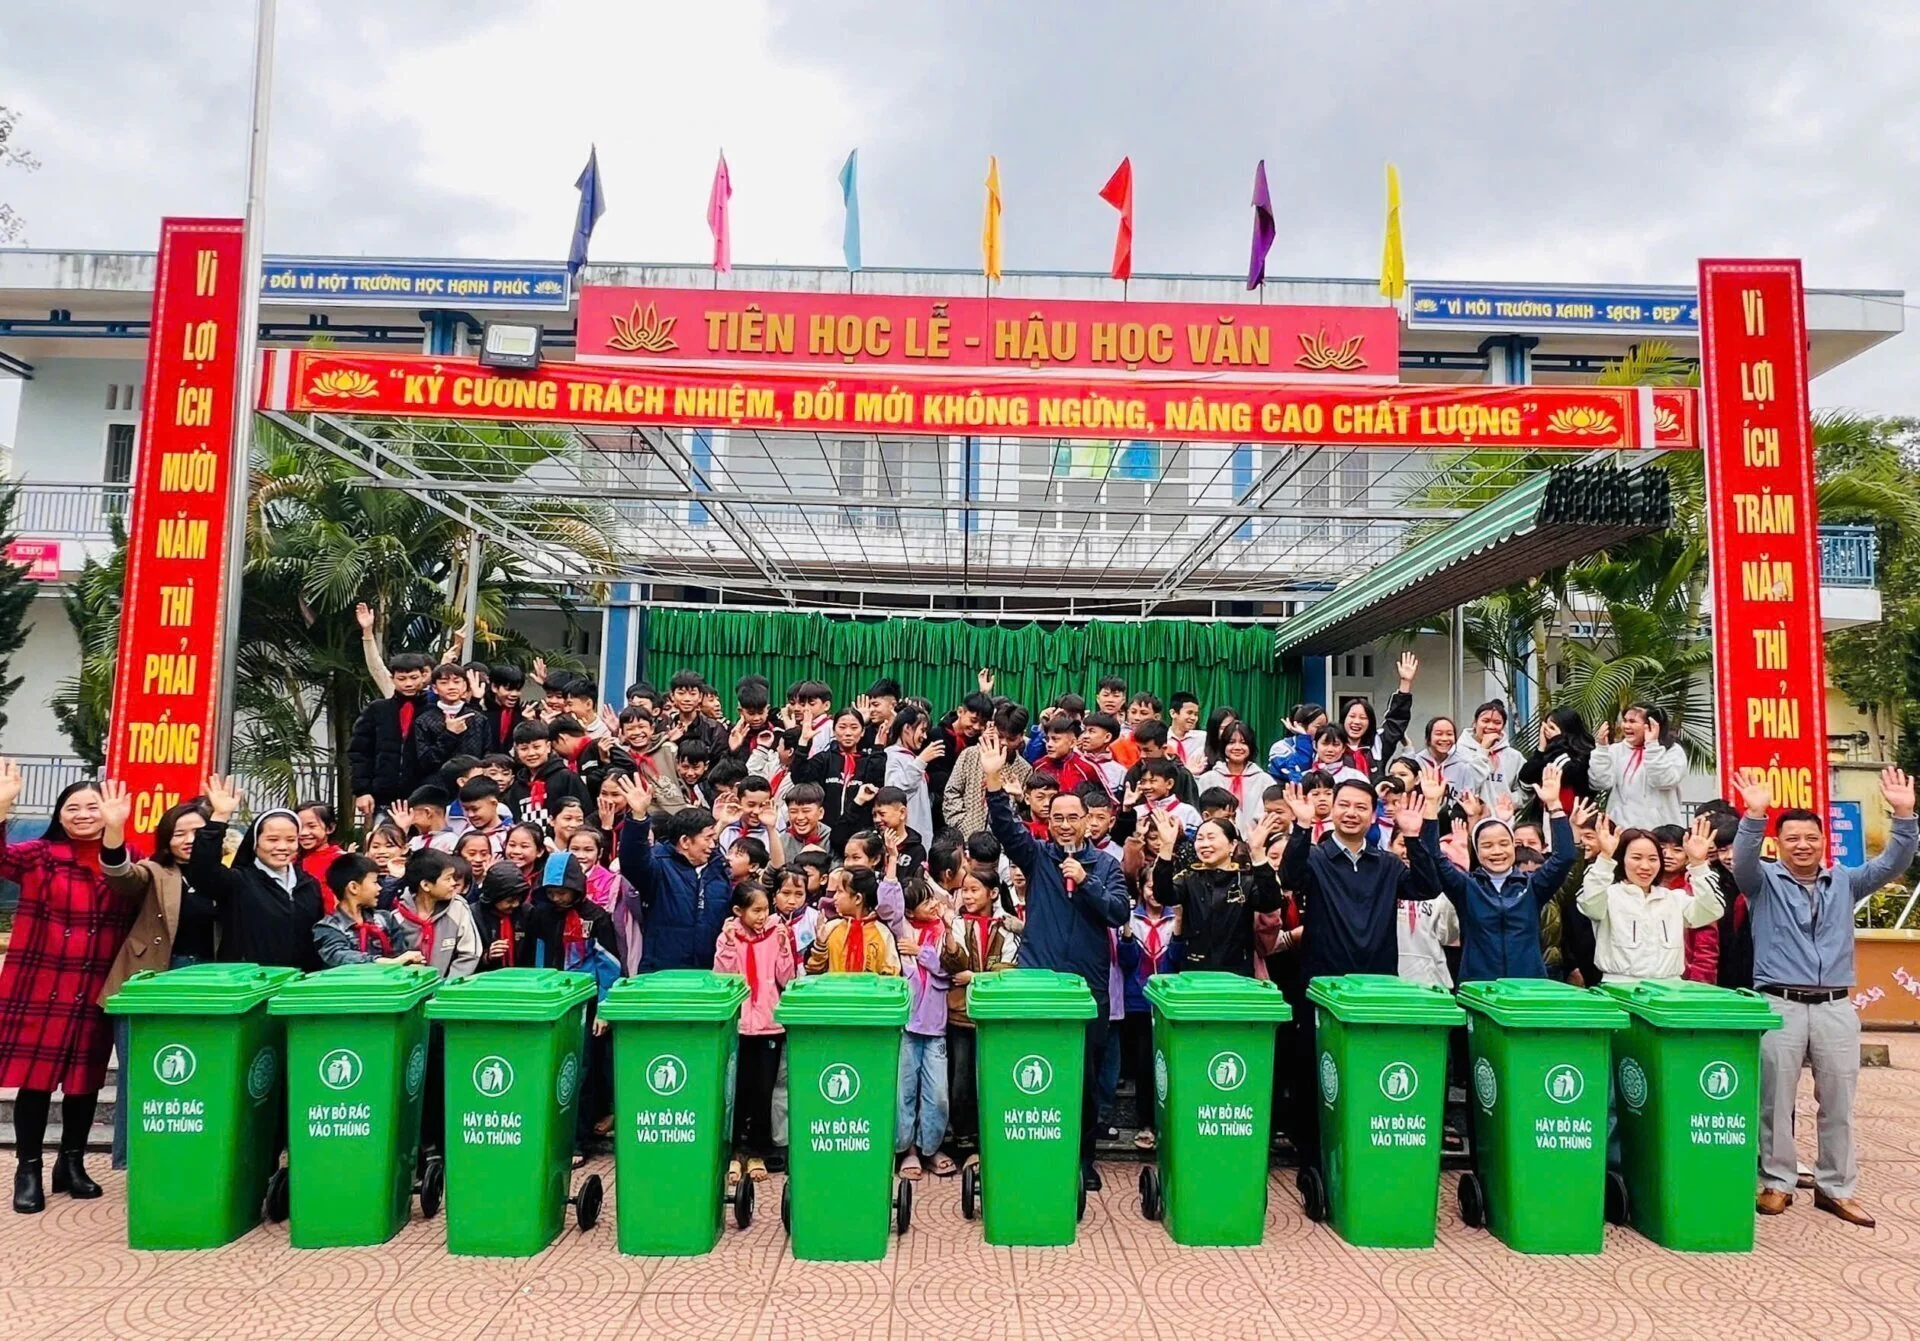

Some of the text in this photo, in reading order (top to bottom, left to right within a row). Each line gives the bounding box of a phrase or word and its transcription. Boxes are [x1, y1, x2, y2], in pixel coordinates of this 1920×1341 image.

[196, 250, 218, 296] VÌ
[270, 270, 296, 289] ĐỔI
[300, 271, 314, 288] VÌ
[318, 273, 348, 293] MỘT
[352, 274, 410, 292] TRƯỜNG
[415, 277, 444, 295] HỌC
[448, 279, 488, 296] HẠNH
[493, 277, 530, 294] PHÚC
[1466, 298, 1491, 315] MÔI
[1495, 300, 1552, 318] TRƯỜNG
[1556, 304, 1594, 318] XANH
[1606, 306, 1640, 321] SẠCH
[1742, 289, 1764, 336] VÌ
[704, 302, 1270, 370] TIÊN HỌC LỄ - HẬU HỌC VĂN
[183, 320, 217, 370] LỢI
[1740, 359, 1774, 410] LỢI
[176, 379, 213, 426] ÍCH
[452, 376, 557, 410] CƯƠNG
[568, 379, 665, 415] TRÁCH
[674, 382, 783, 424] NHIỆM,
[793, 380, 844, 421] ĐỔI
[855, 384, 914, 424] MỚI
[924, 390, 1028, 426] KHÔNG
[1038, 392, 1154, 433] NGỪNG,
[1165, 396, 1250, 432] NÂNG
[1261, 403, 1322, 434] CAO
[1334, 396, 1411, 435] CHẤT
[1744, 419, 1780, 467] ÍCH
[160, 443, 217, 493] MƯỜI
[1733, 486, 1795, 534] TRĂM
[156, 511, 208, 559] NĂM
[1742, 552, 1794, 602] NĂM
[160, 578, 194, 626] THÌ
[1753, 621, 1788, 670] THÌ
[143, 638, 197, 695] PHẢI
[1748, 680, 1800, 739] PHẢI
[128, 708, 200, 764] TRỒNG
[182, 1100, 204, 1114] RÁC
[348, 1104, 370, 1120] RÁC
[1234, 1104, 1252, 1120] RÁC
[142, 1116, 204, 1132] VÀO THÙNG
[500, 1112, 522, 1128] RÁC
[674, 1110, 696, 1126] RÁC
[1042, 1108, 1060, 1124] RÁC
[1406, 1114, 1426, 1130] RÁC
[1726, 1114, 1746, 1128] RÁC
[308, 1120, 370, 1136] VÀO THÙNG
[848, 1118, 870, 1134] RÁC
[1004, 1124, 1062, 1140] VÀO THÙNG
[1198, 1120, 1252, 1136] VÀO THÙNG
[1572, 1118, 1592, 1132] RÁC
[464, 1128, 522, 1144] VÀO THÙNG
[636, 1126, 696, 1142] VÀO THÙNG
[1372, 1130, 1426, 1146] VÀO THÙNG
[1536, 1132, 1592, 1148] VÀO THÙNG
[1690, 1128, 1746, 1144] VÀO THÙNG
[812, 1136, 870, 1152] VÀO THÙNG
